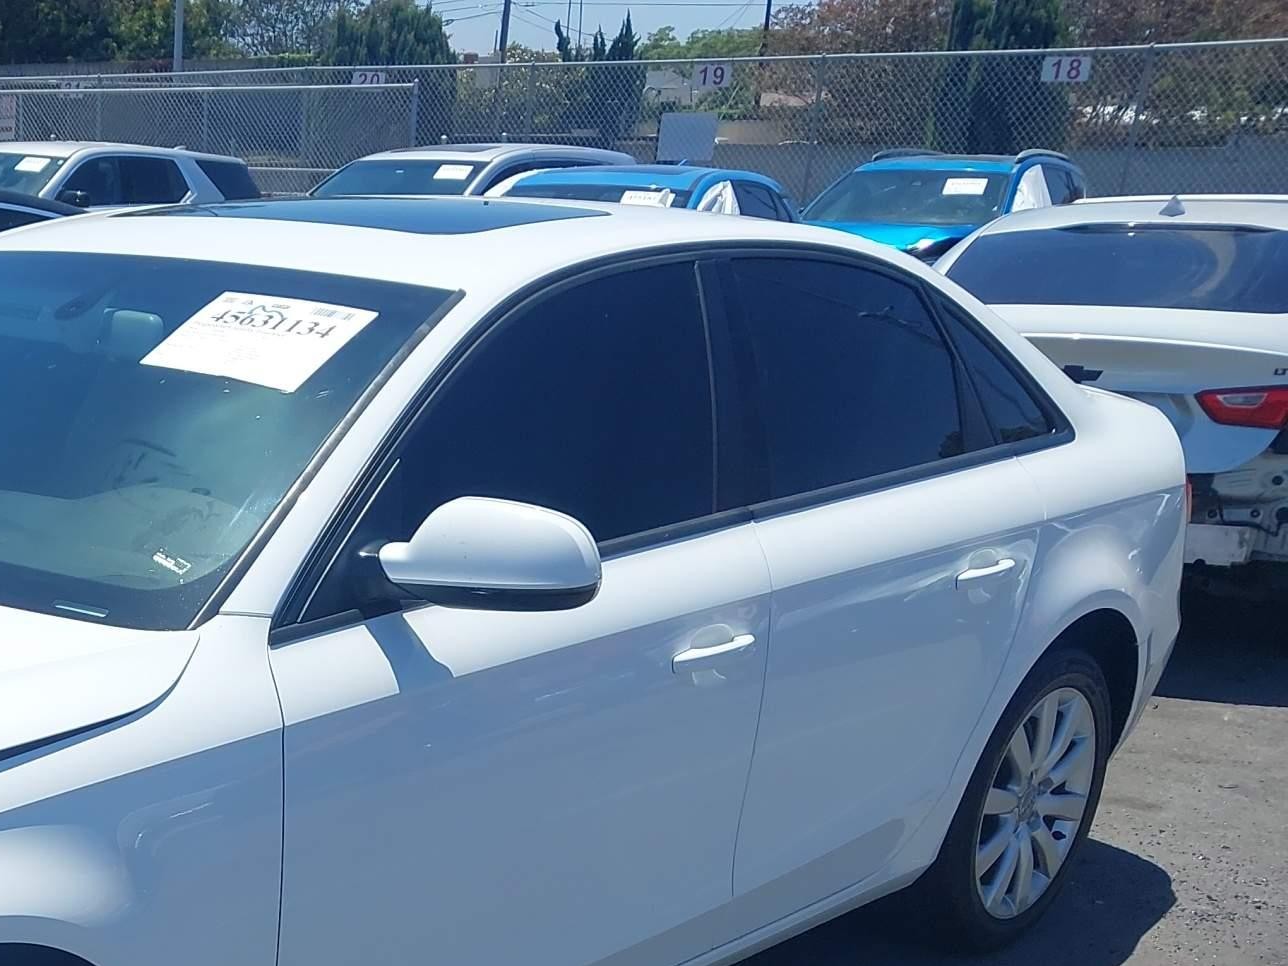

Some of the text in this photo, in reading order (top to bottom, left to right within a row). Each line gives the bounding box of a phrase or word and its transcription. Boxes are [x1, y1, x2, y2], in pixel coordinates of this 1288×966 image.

[359, 72, 380, 85] 20
[699, 66, 724, 86] 19
[1052, 58, 1081, 80] 18
[211, 309, 337, 338] 45631134
